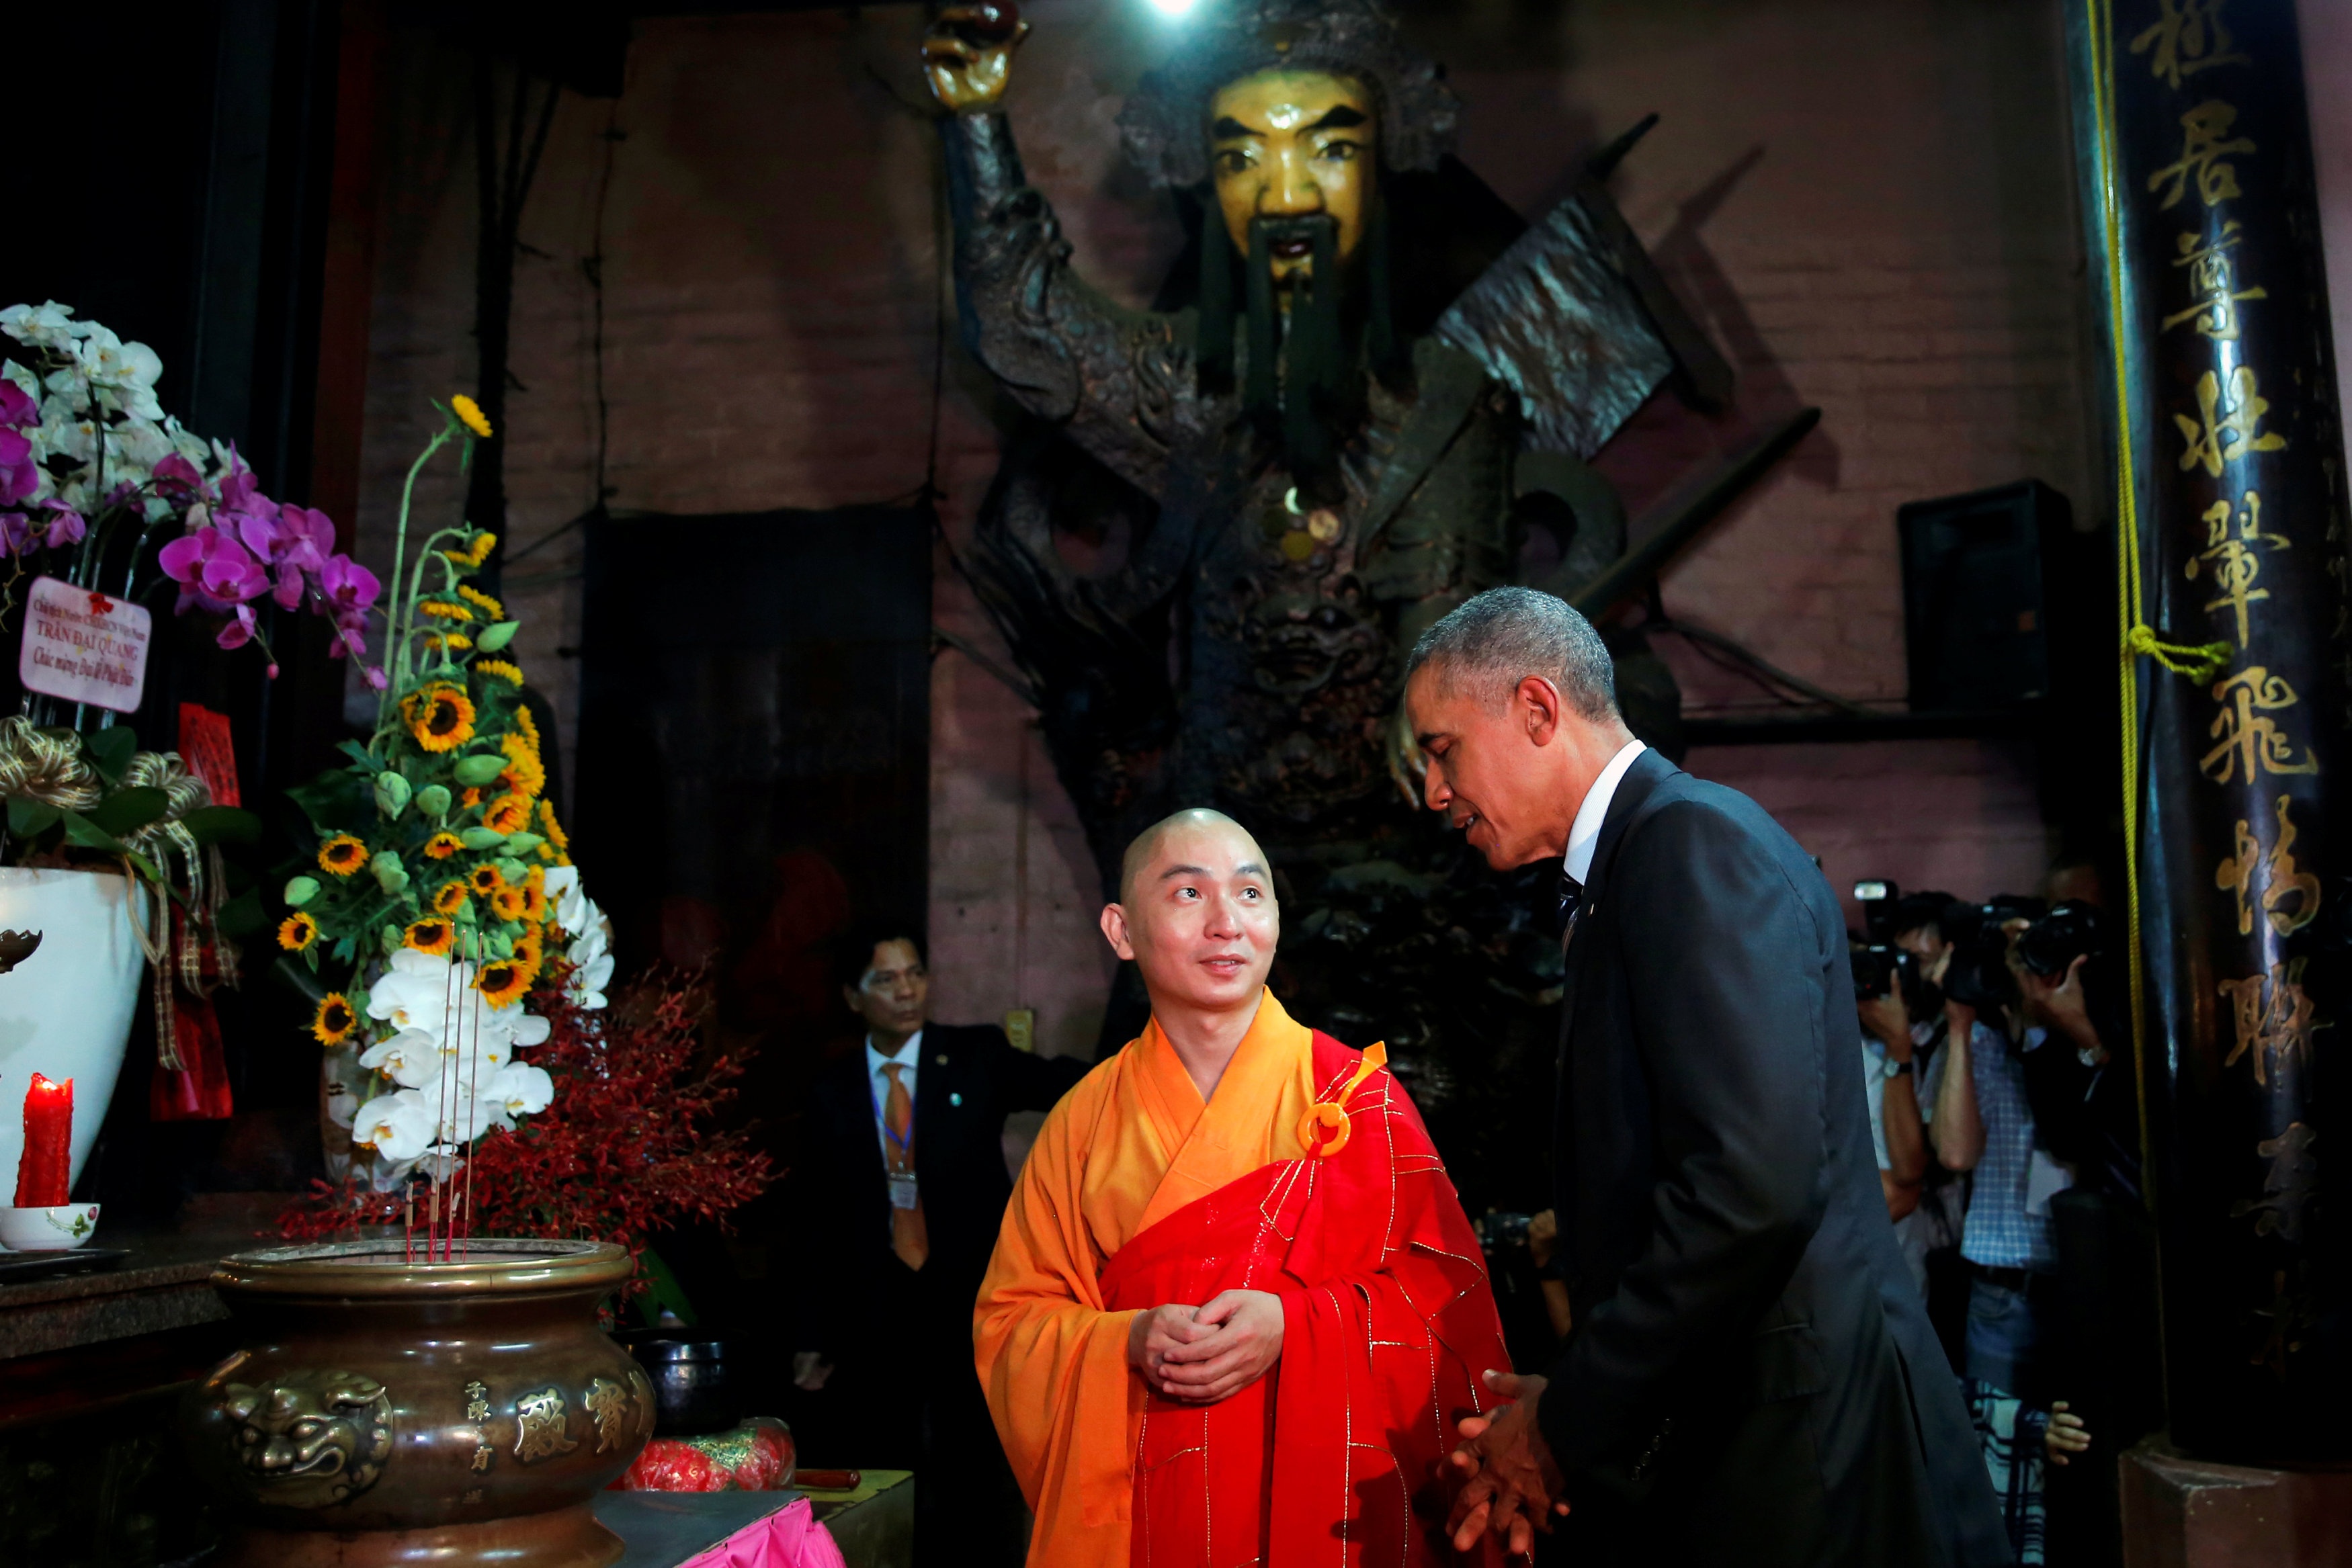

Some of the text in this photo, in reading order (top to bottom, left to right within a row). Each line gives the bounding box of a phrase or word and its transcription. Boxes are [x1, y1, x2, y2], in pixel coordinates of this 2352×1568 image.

[36, 619, 138, 661] TRẦN ĐẠI QUANG
